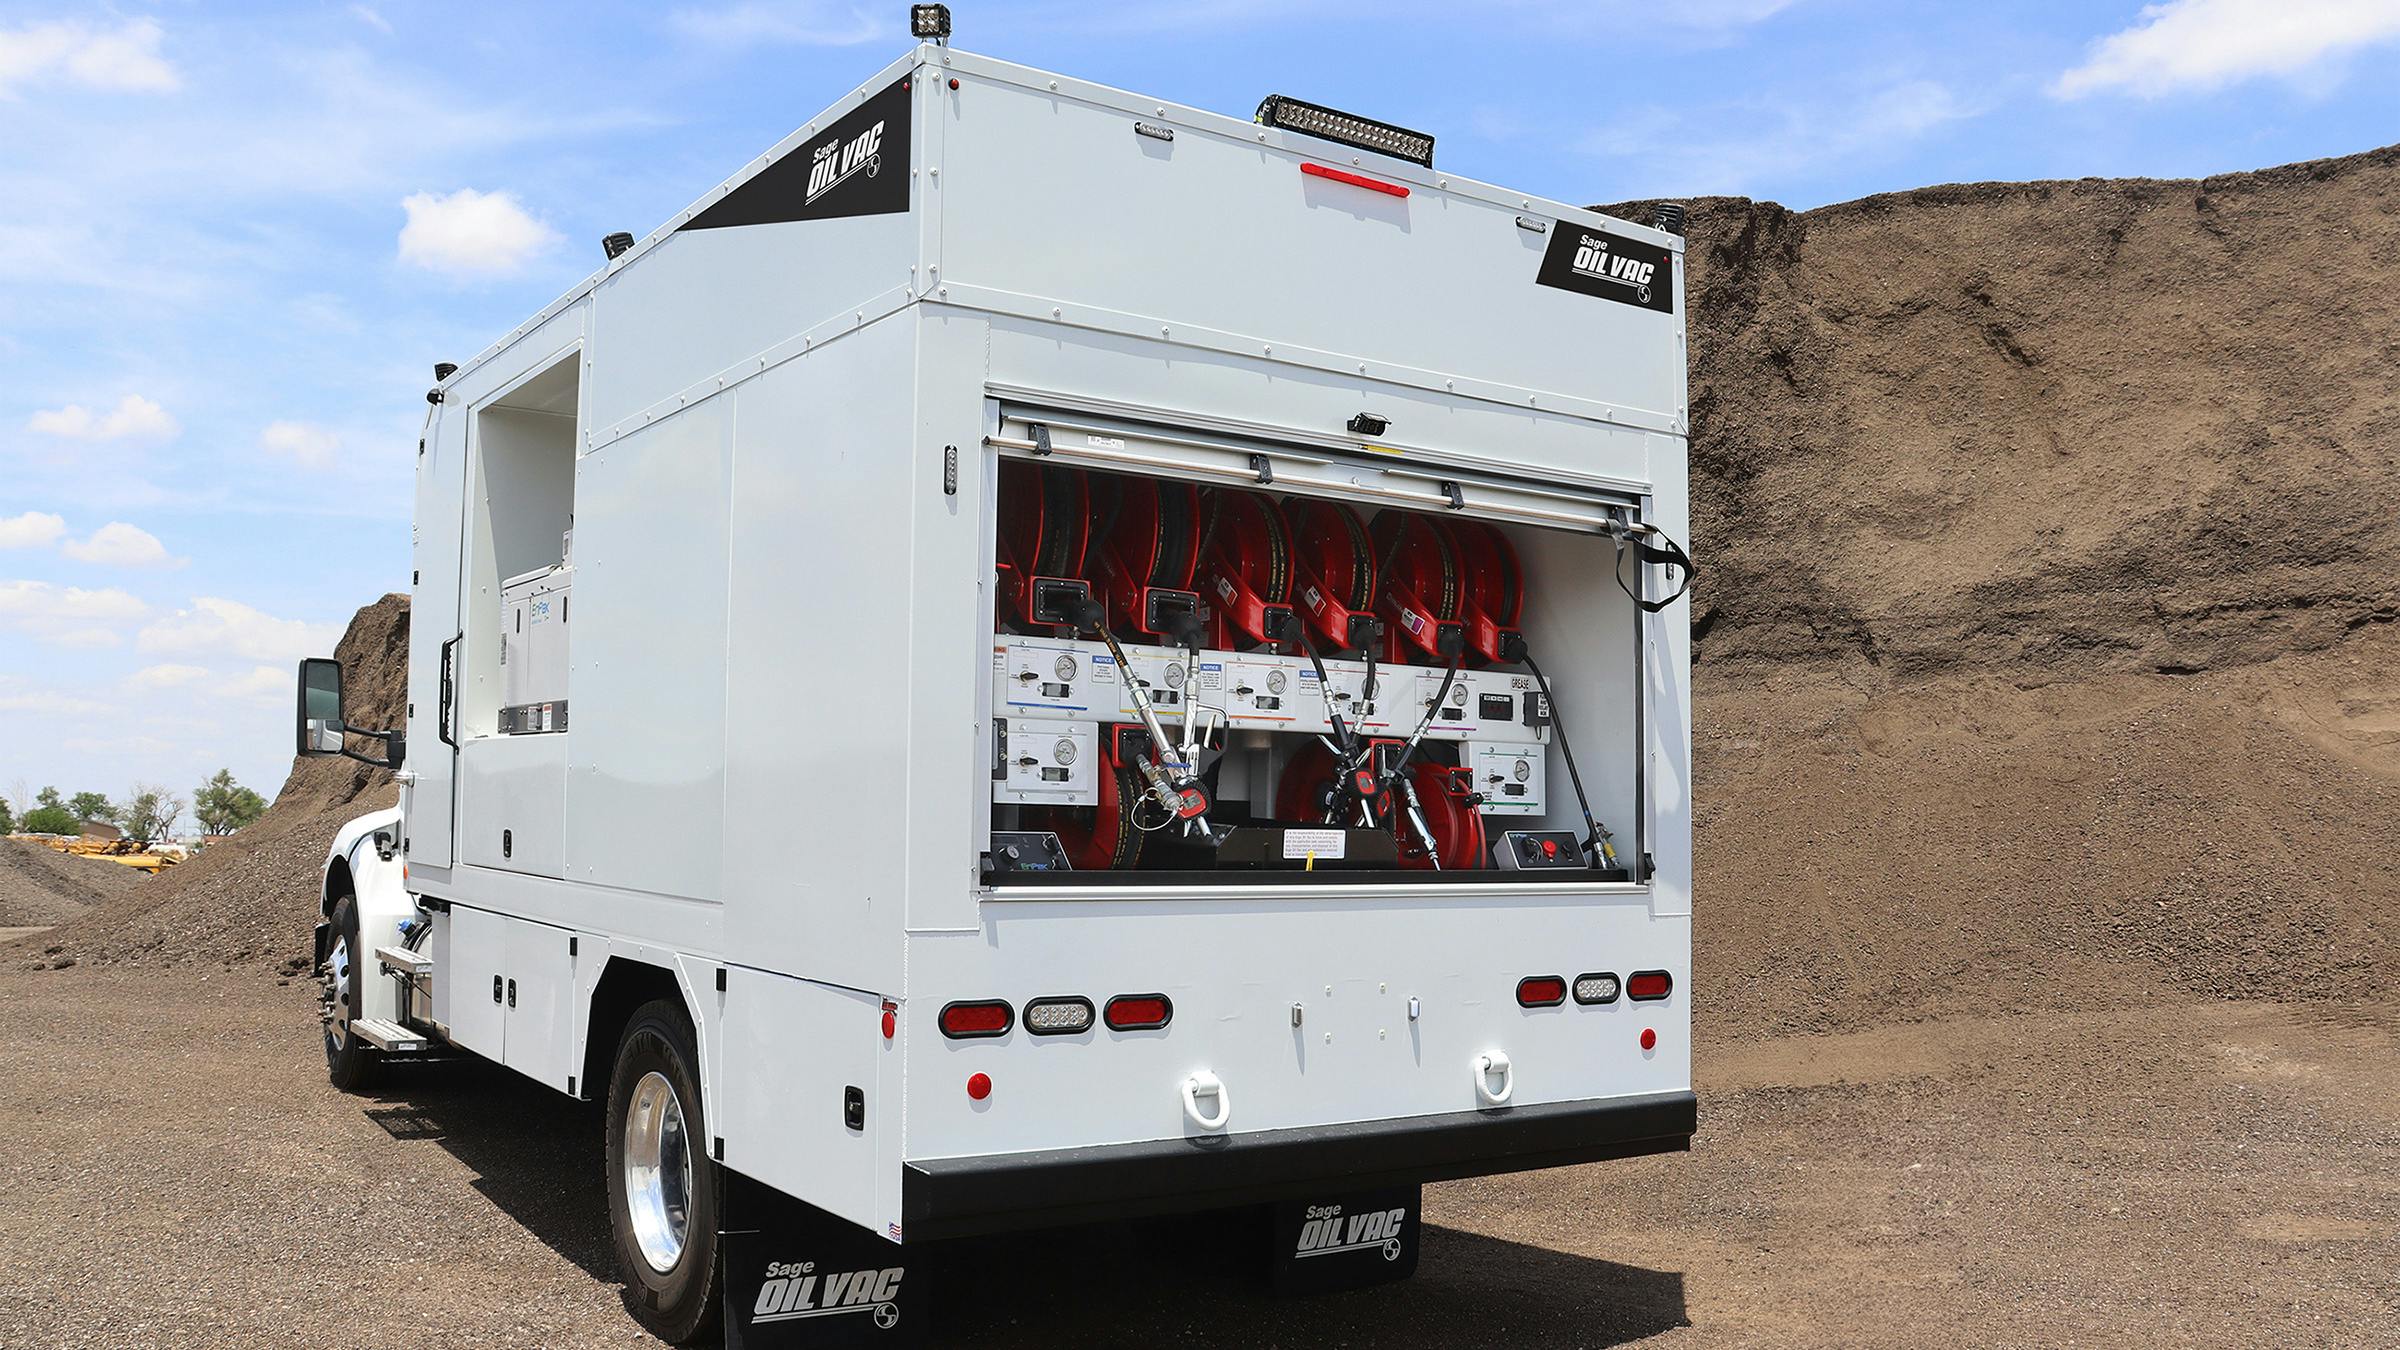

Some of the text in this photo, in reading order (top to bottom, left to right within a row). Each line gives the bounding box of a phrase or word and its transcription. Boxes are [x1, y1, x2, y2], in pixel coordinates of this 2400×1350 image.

[806, 120, 885, 198] OIL VAC
[812, 138, 839, 164] Sage
[1580, 234, 1608, 250] Sage
[1573, 246, 1655, 285] OIL VAC
[1511, 678, 1529, 690] GREASE
[1306, 1205, 1341, 1219] Sage
[1297, 1208, 1405, 1251] OIL VAC
[765, 1261, 815, 1279] Sage
[753, 1267, 904, 1315] OIL VAC
